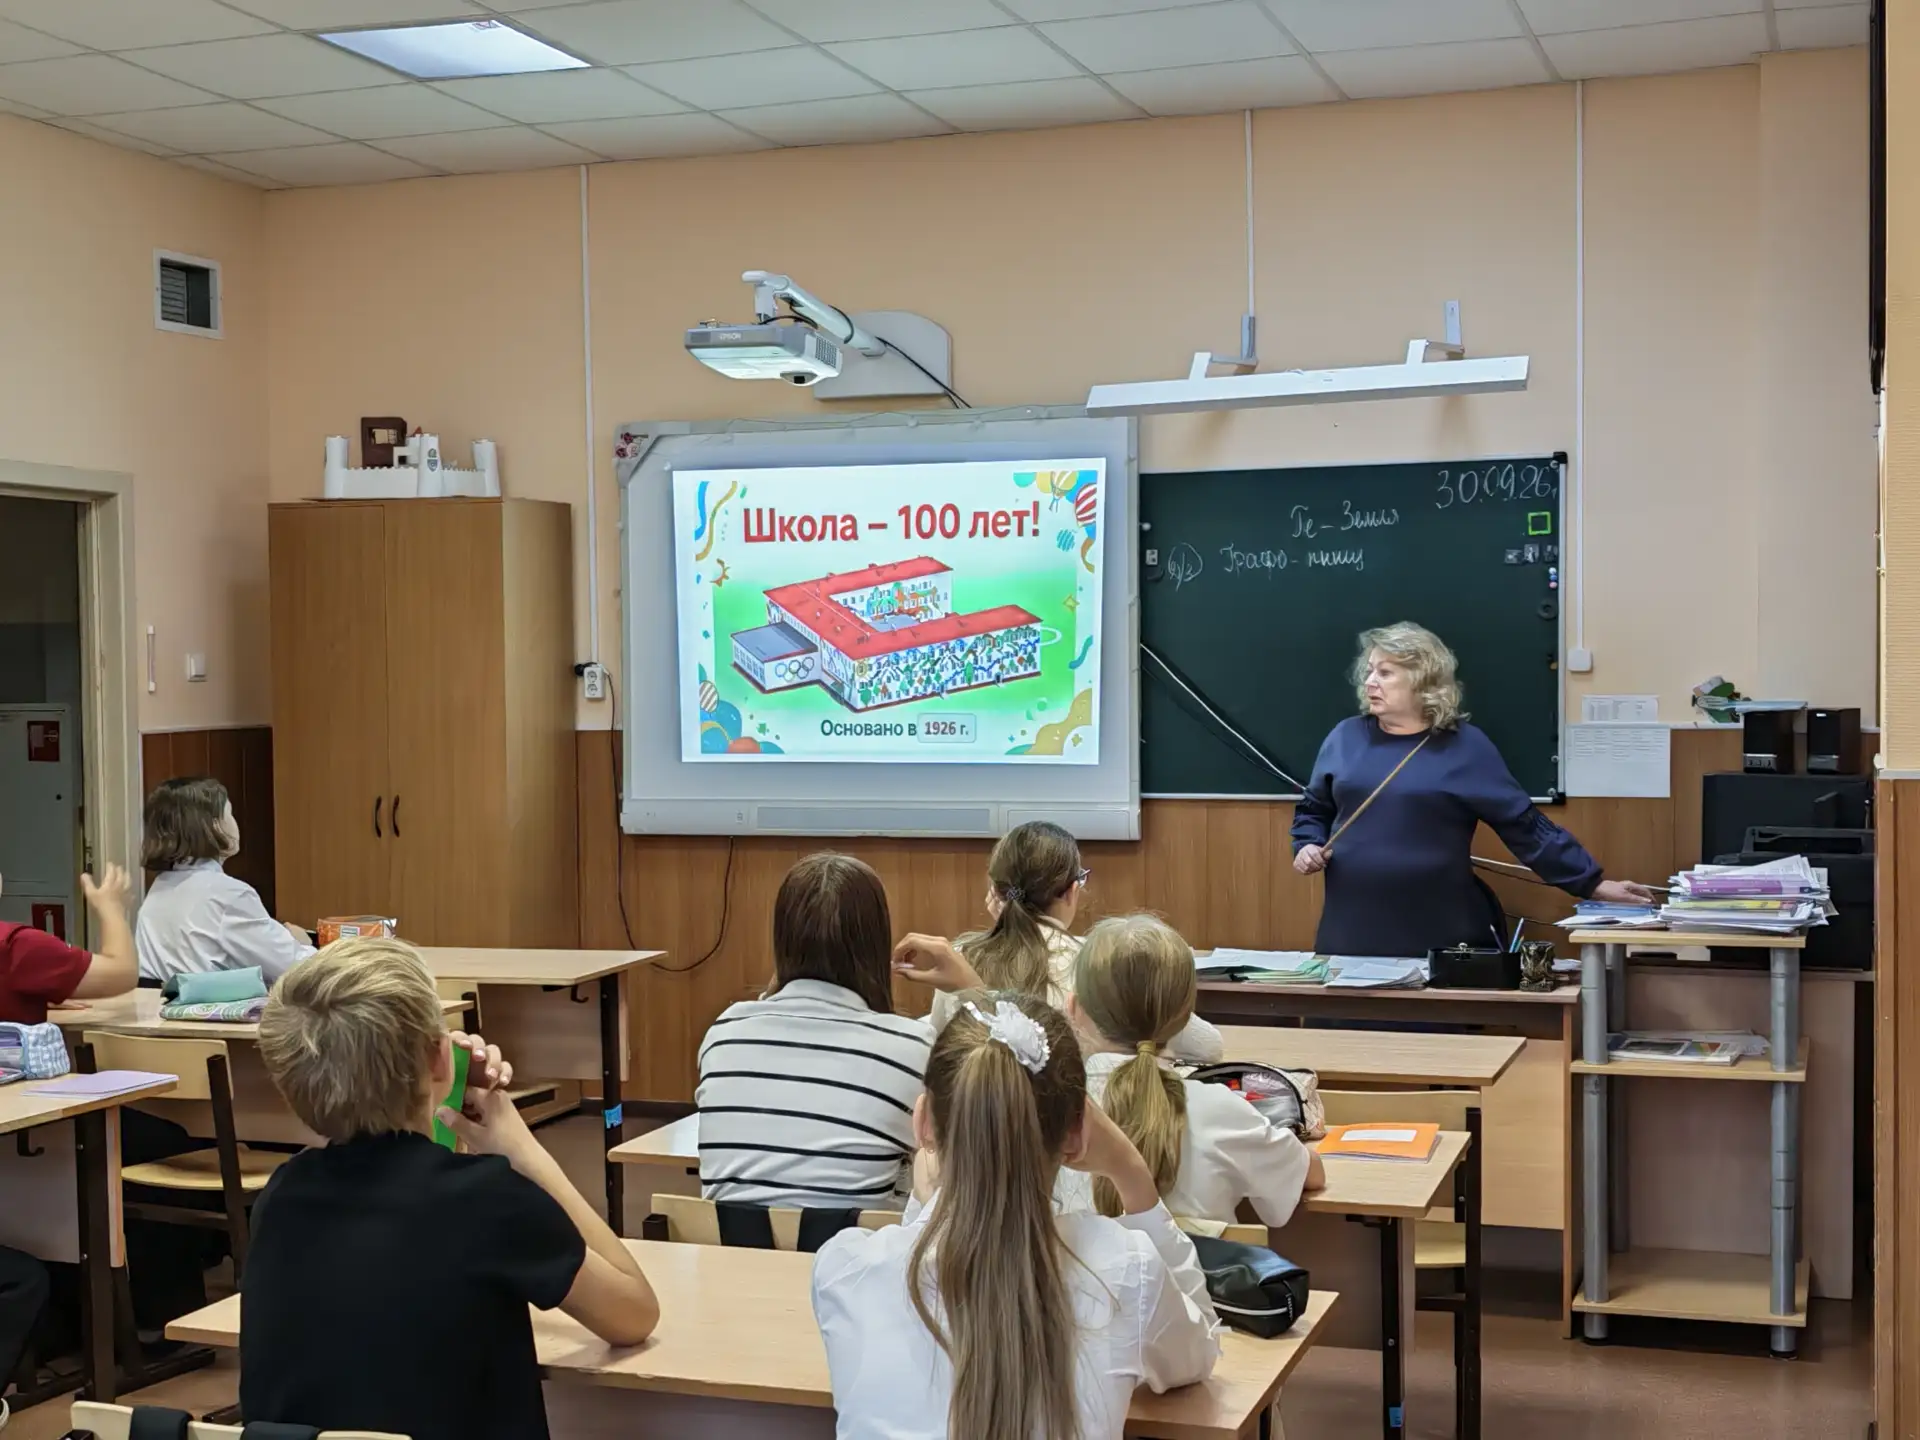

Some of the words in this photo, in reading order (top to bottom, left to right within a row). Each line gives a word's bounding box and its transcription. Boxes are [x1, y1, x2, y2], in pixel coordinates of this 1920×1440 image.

[743, 507, 859, 543] Школа
[897, 503, 960, 540] 100
[968, 500, 1040, 538] лет!
[820, 719, 904, 737] Основано
[907, 722, 918, 736] в
[924, 721, 957, 736] 1926
[960, 724, 970, 736] г.
